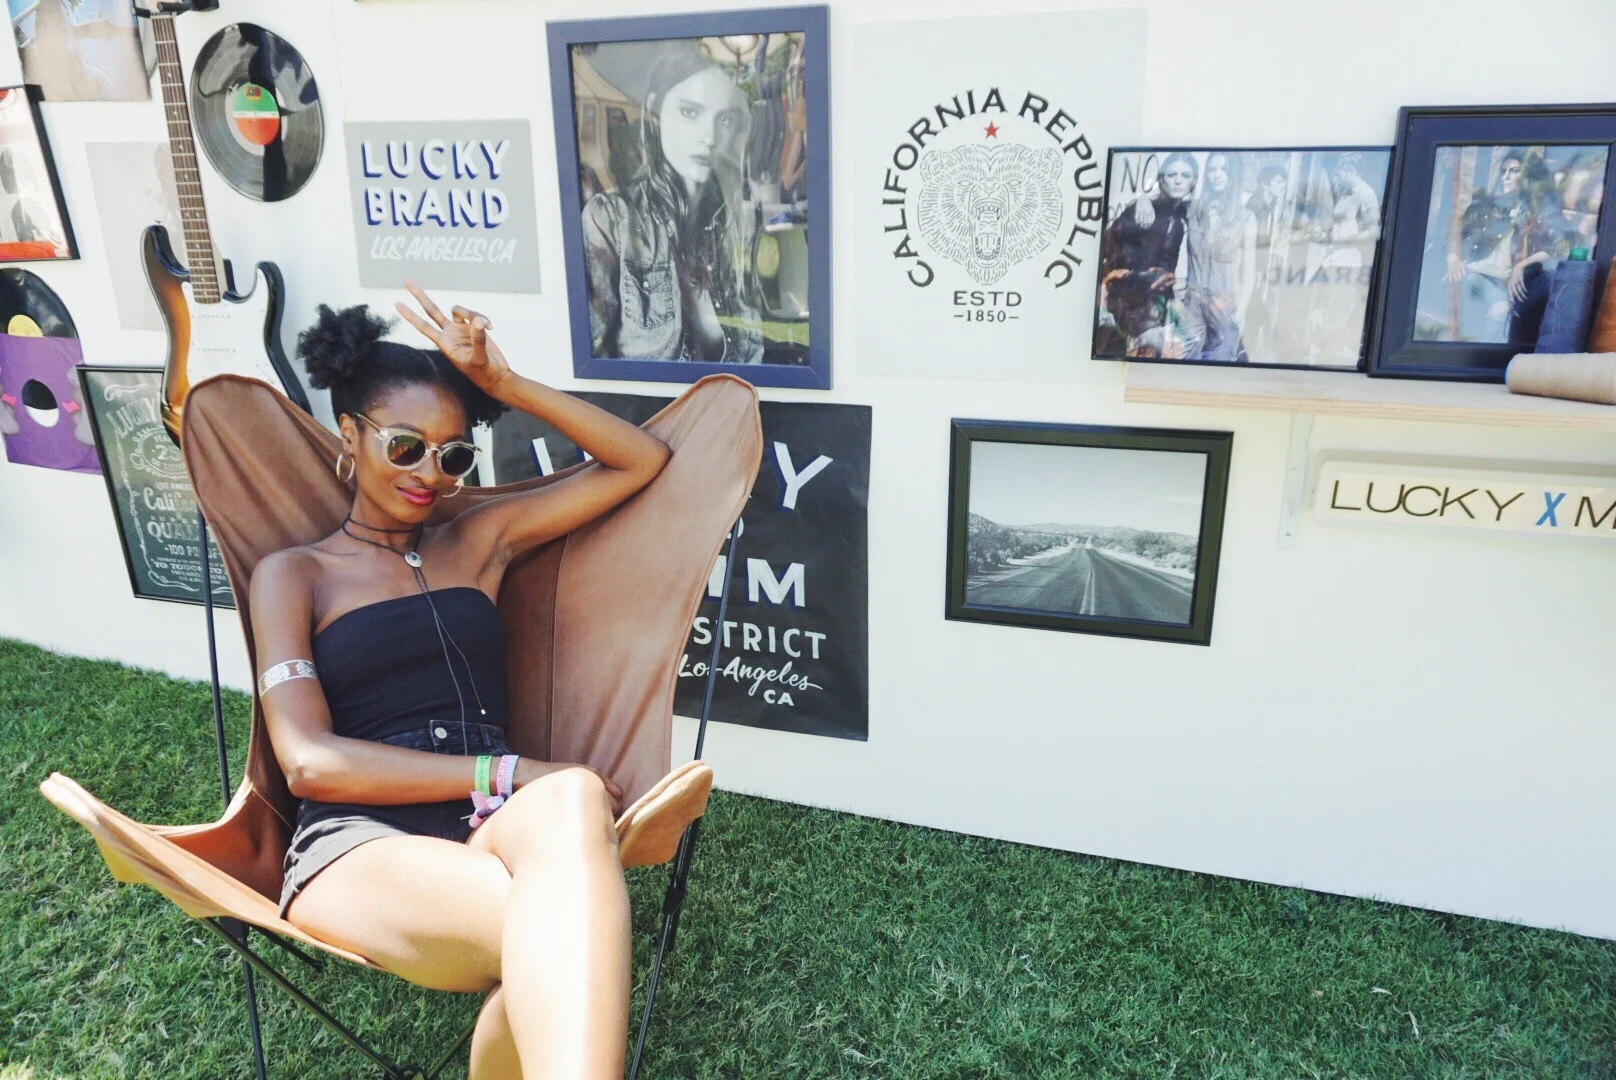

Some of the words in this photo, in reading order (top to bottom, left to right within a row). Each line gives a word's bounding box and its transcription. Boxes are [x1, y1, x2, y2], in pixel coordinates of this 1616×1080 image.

[361, 138, 511, 180] LUCKY
[1120, 153, 1159, 193] NO
[364, 186, 510, 229] BRAND
[882, 87, 1009, 287] CALIFORNIA
[1018, 90, 1104, 289] REPUBLIC
[370, 234, 406, 261] LOS
[404, 235, 485, 262] ANGELES
[487, 237, 517, 263] CA
[953, 290, 1022, 307] ESTD
[1330, 480, 1525, 521] LUCKY
[1535, 491, 1566, 527] X
[693, 616, 827, 659] STRICT
[678, 653, 723, 677] Lo
[722, 656, 823, 696] Angeles
[763, 689, 795, 706] CA
